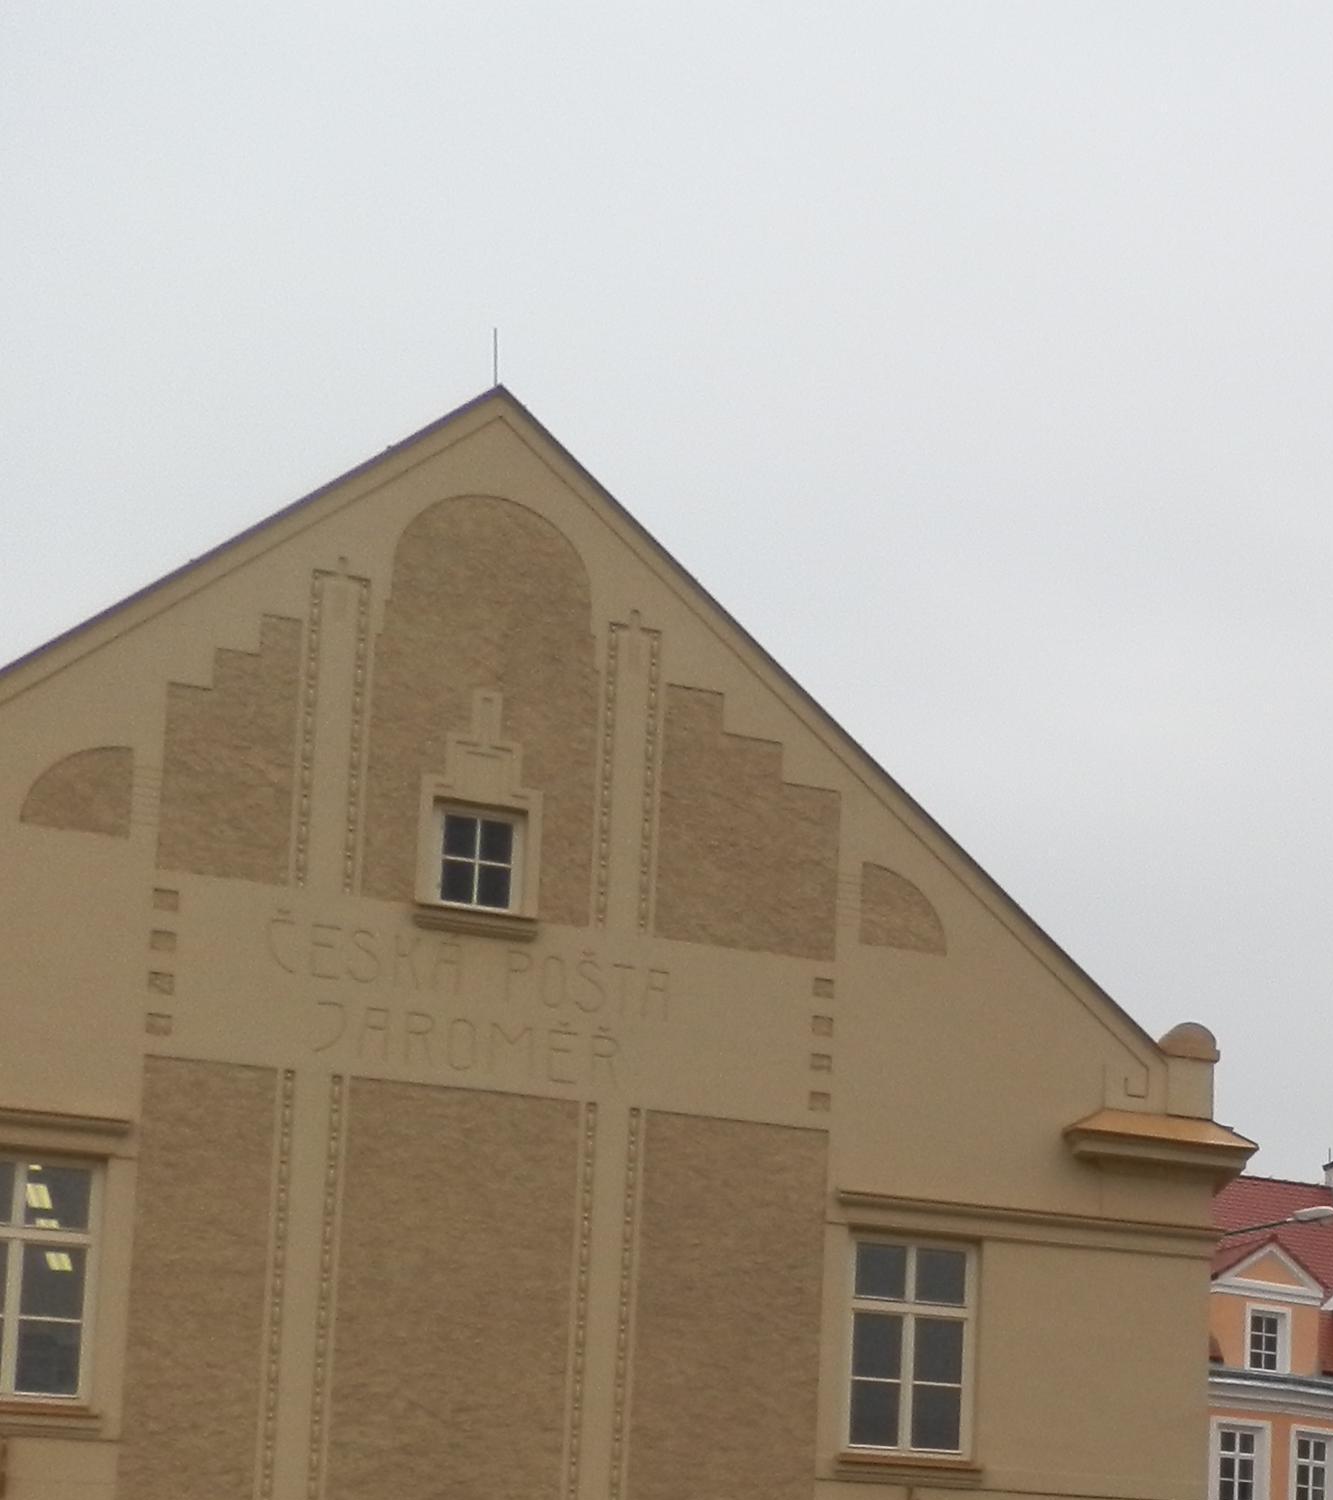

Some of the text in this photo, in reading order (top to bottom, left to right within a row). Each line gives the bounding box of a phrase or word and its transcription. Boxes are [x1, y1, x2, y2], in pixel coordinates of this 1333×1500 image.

[266, 907, 671, 1023] ČESKÁ POŠTA
[312, 1001, 622, 1090] JAROMĚŘ
